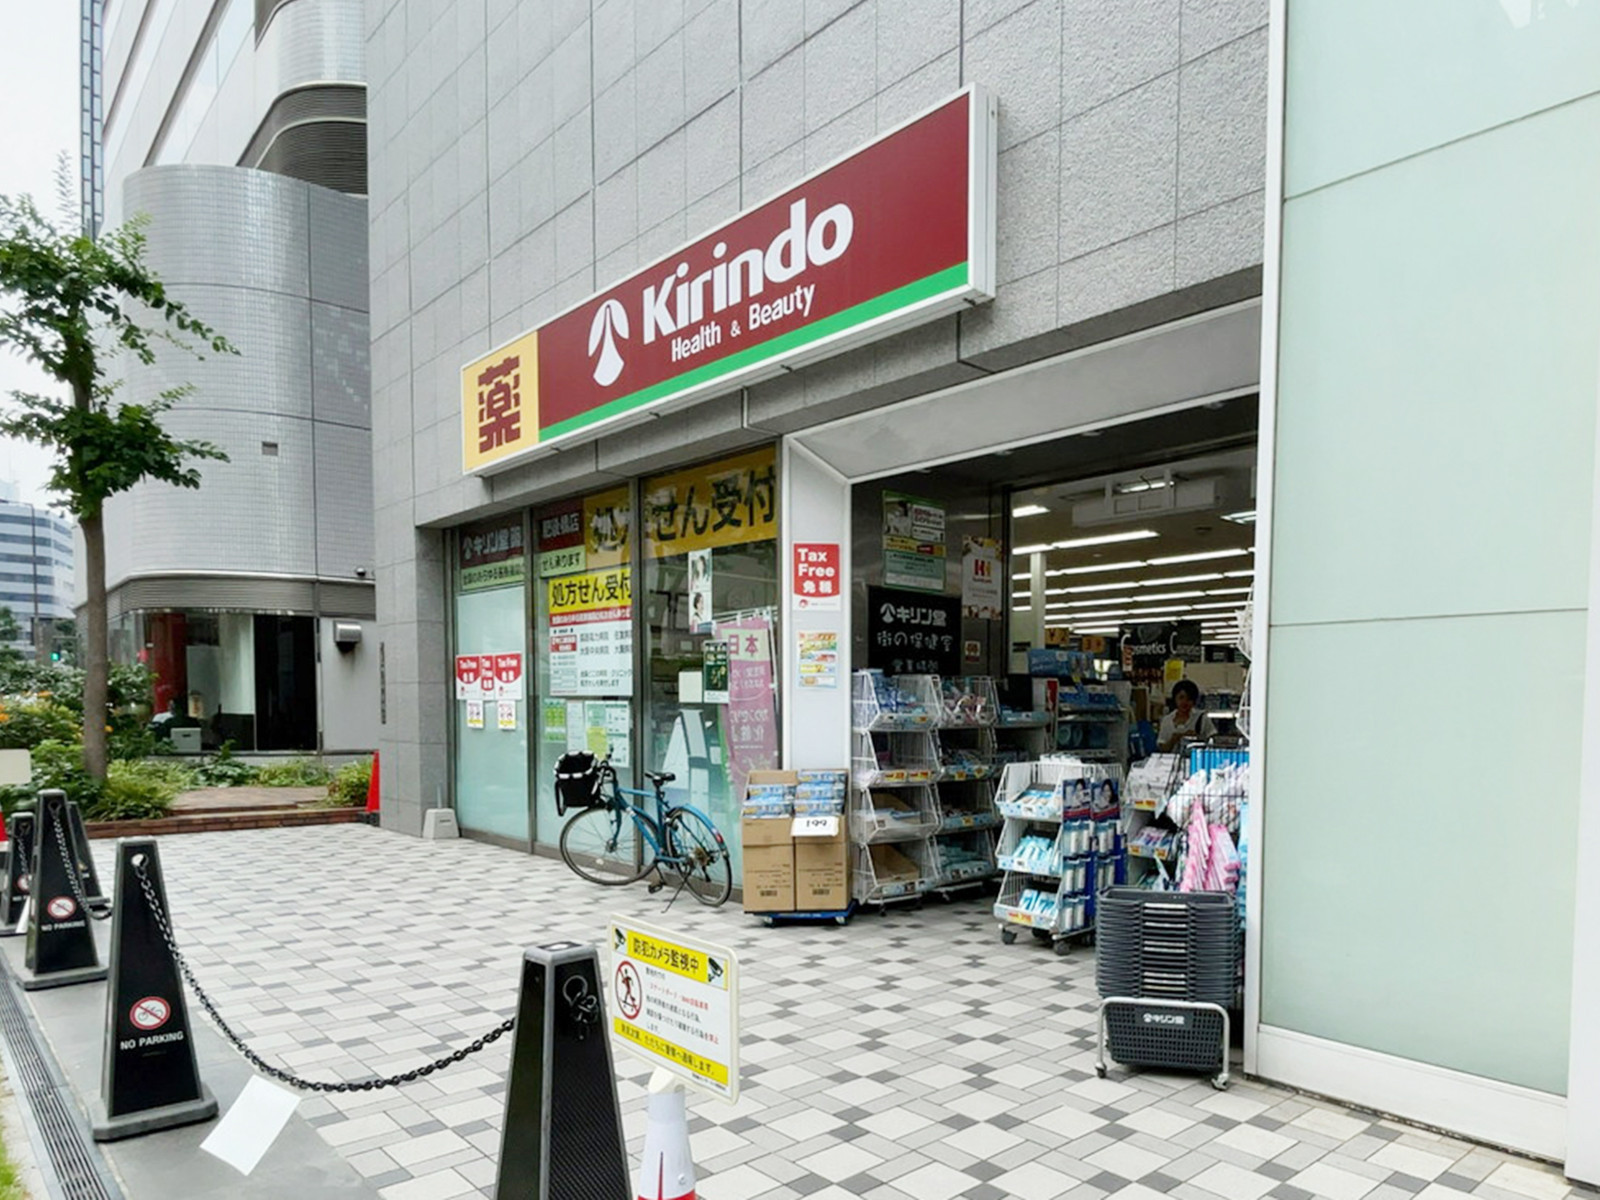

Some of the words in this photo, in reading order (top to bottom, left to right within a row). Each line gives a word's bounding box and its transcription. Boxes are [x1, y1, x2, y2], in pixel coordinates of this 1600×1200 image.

[643, 198, 853, 345] Kirindo
[671, 321, 721, 362] Health
[730, 319, 742, 338] &
[749, 284, 815, 331] Beauty
[478, 354, 521, 454] 薬
[798, 548, 827, 562] Tax
[798, 563, 835, 577] Free
[552, 573, 631, 607] 処方せん受付
[729, 634, 758, 656] 日本
[41, 924, 53, 932] NO
[54, 920, 86, 931] PARKING
[120, 1039, 136, 1050] NO
[139, 1030, 184, 1048] PARKING
